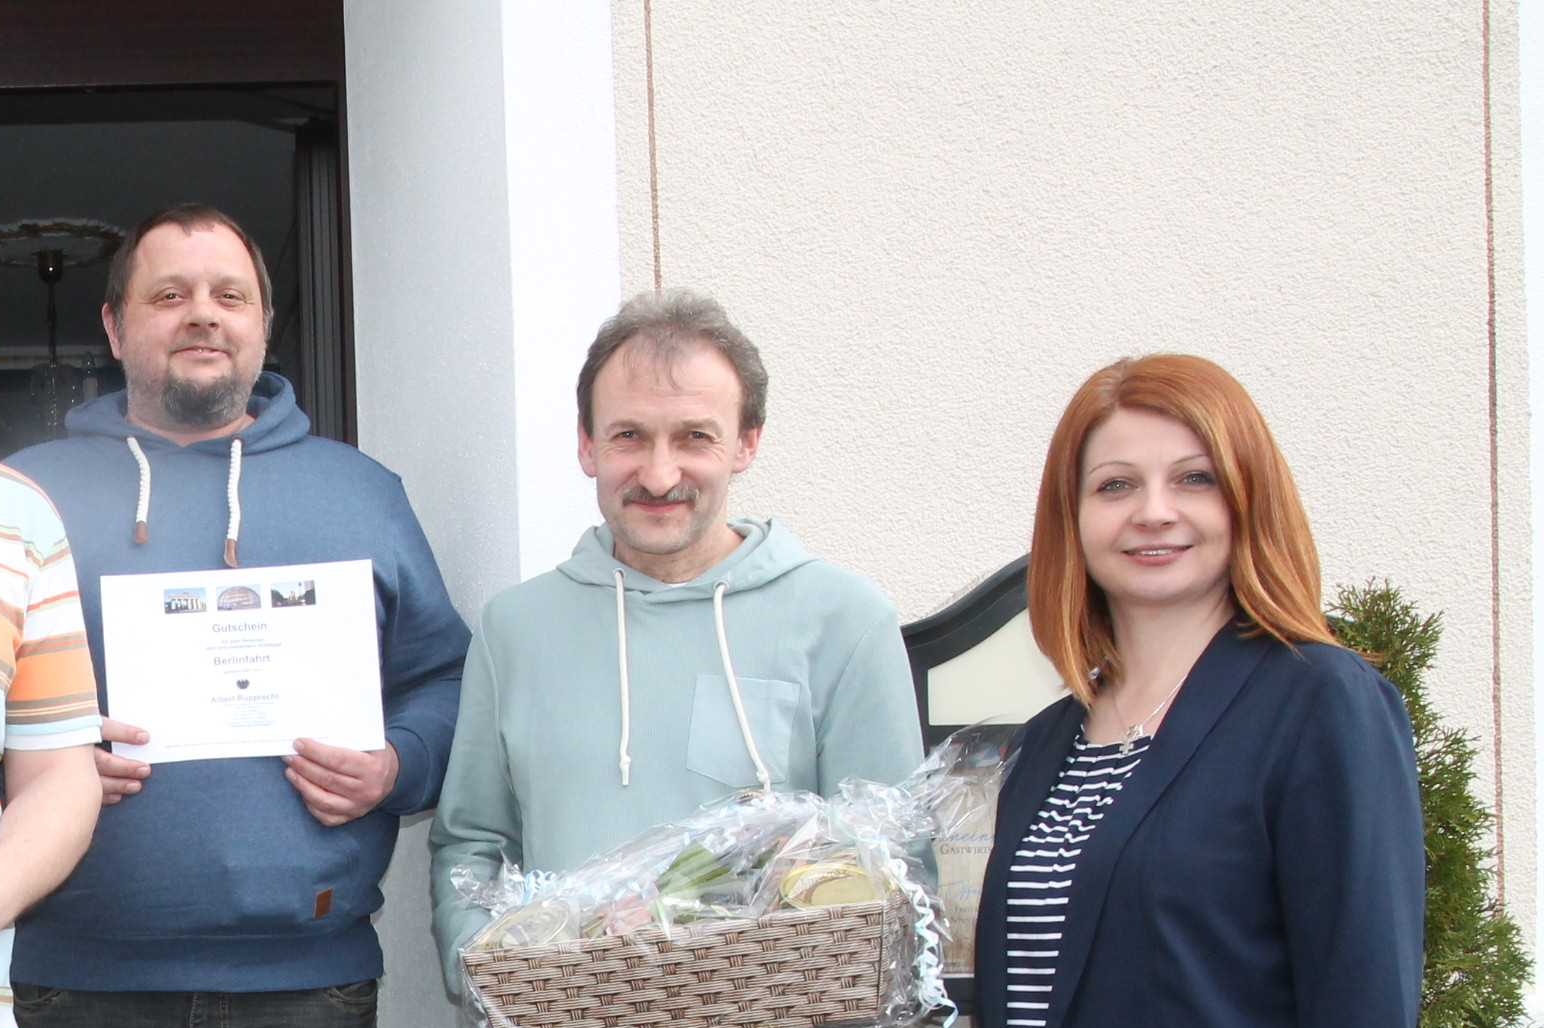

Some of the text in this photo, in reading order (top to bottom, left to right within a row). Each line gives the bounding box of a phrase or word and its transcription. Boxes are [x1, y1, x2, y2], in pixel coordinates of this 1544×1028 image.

[212, 621, 268, 634] Gutschein
[213, 655, 270, 666] Berlinfahrt
[211, 693, 279, 703] Albert Rupprecht
